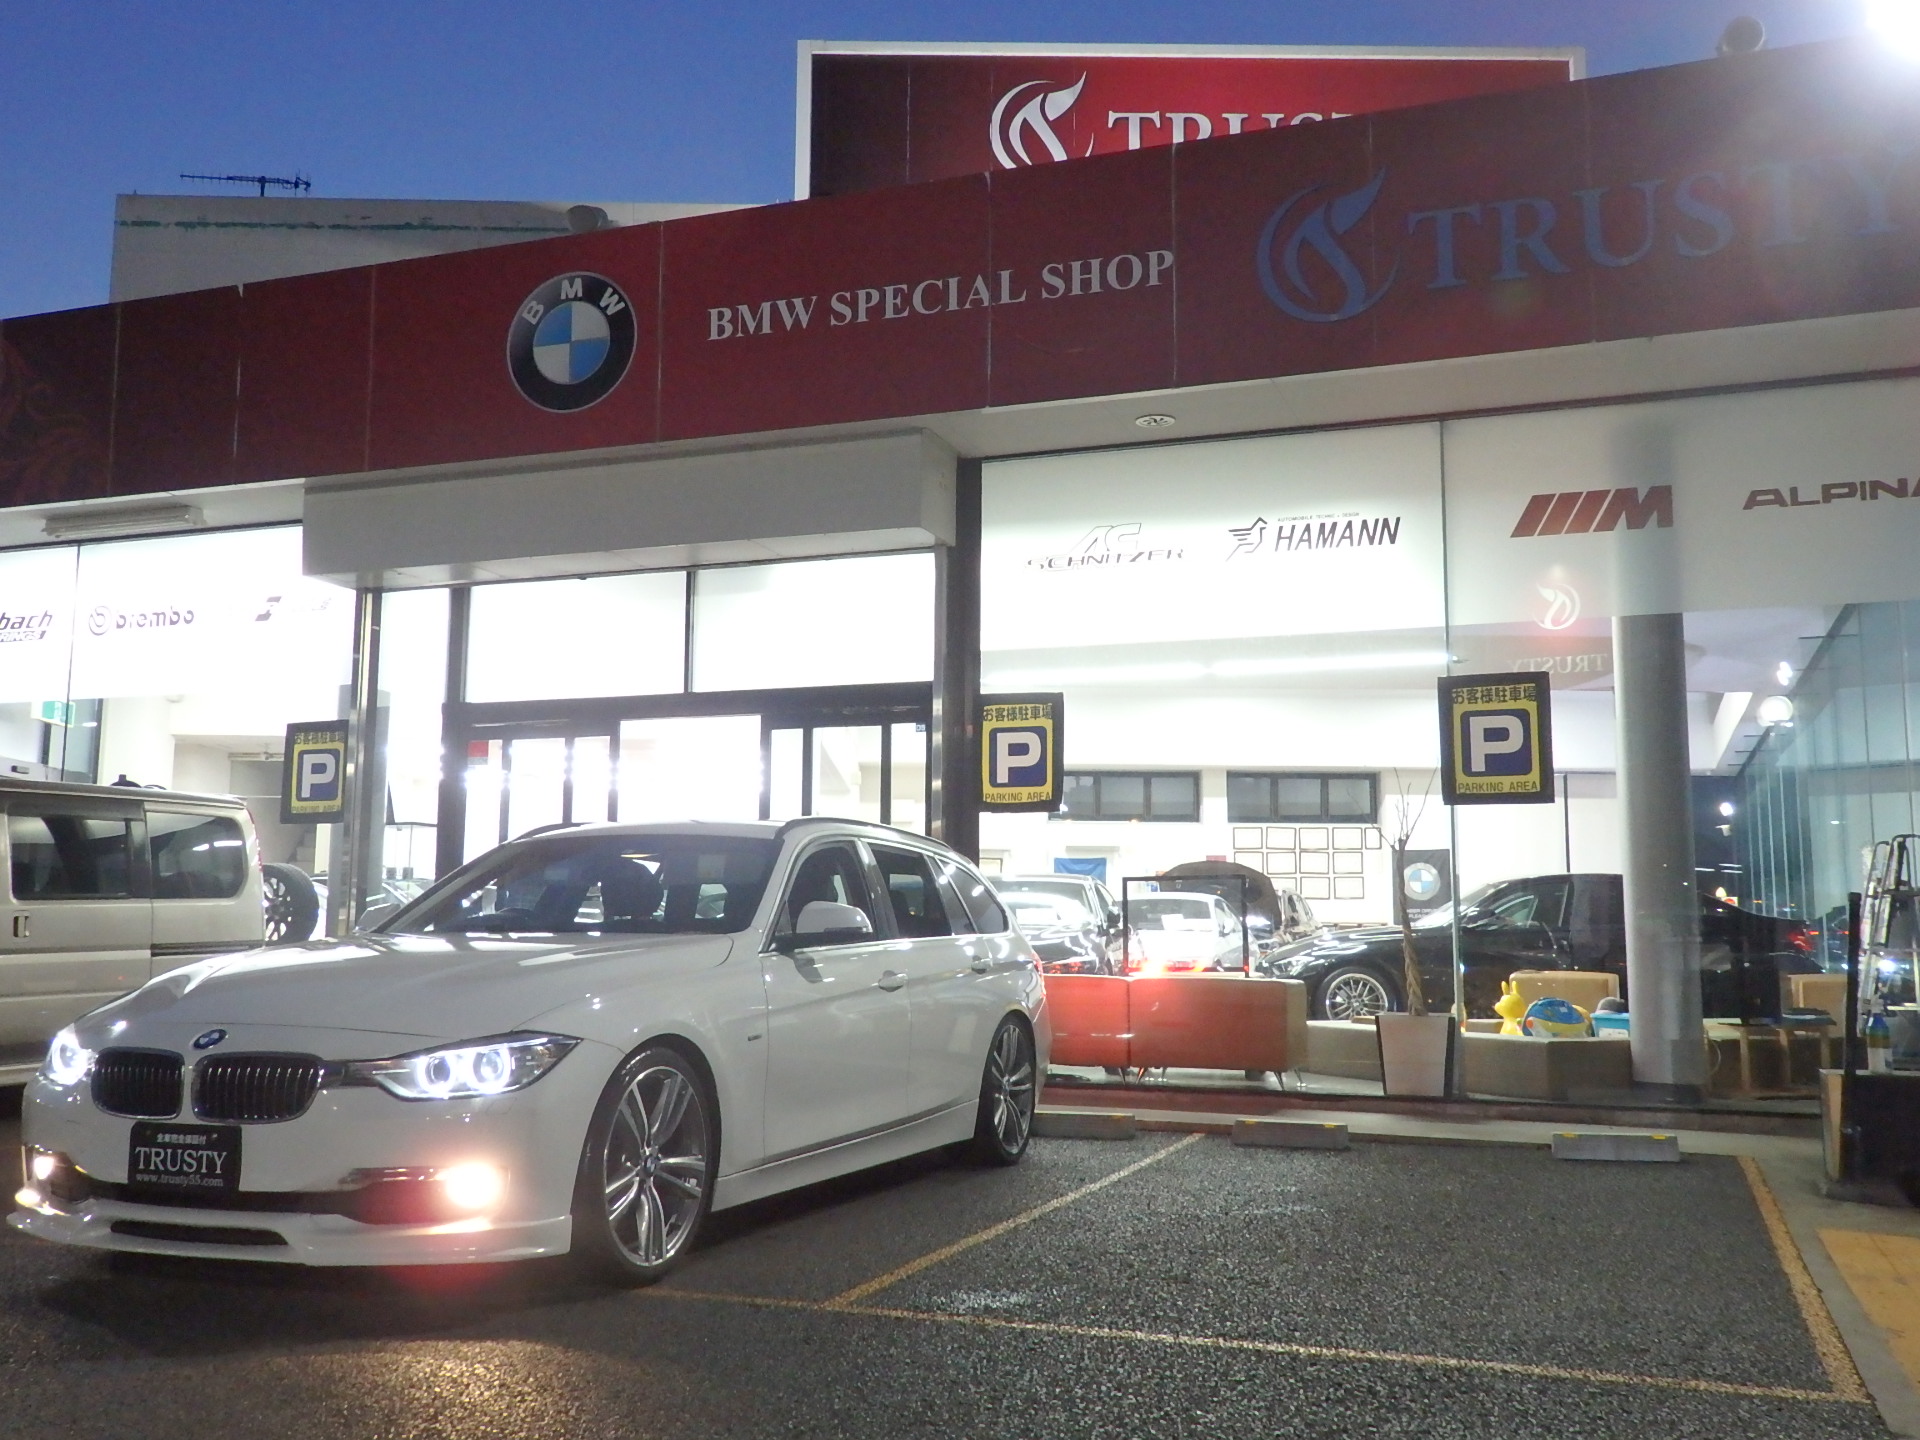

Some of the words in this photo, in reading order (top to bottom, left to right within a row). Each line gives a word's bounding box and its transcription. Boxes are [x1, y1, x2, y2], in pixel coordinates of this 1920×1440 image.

[1408, 148, 1906, 289] TRUSTY
[522, 277, 626, 325] BMW
[707, 296, 818, 341] BMW
[830, 269, 1027, 327] SPECIAL
[1041, 249, 1175, 299] SHOP
[1742, 477, 1920, 510] ALPIN
[1275, 516, 1401, 552] HAMANN
[1452, 685, 1537, 705] お客様駐車場
[983, 705, 1052, 722] お客様駐車場
[997, 732, 1042, 784] P
[1469, 715, 1524, 772] P
[301, 754, 336, 798] P
[1457, 782, 1504, 793] PARKING
[1509, 780, 1538, 791] AREA
[984, 792, 1023, 802] PARKING
[1026, 791, 1051, 801] AREA
[135, 1146, 227, 1173] TRUSTY
[136, 1173, 224, 1187] www.trusty55.com
